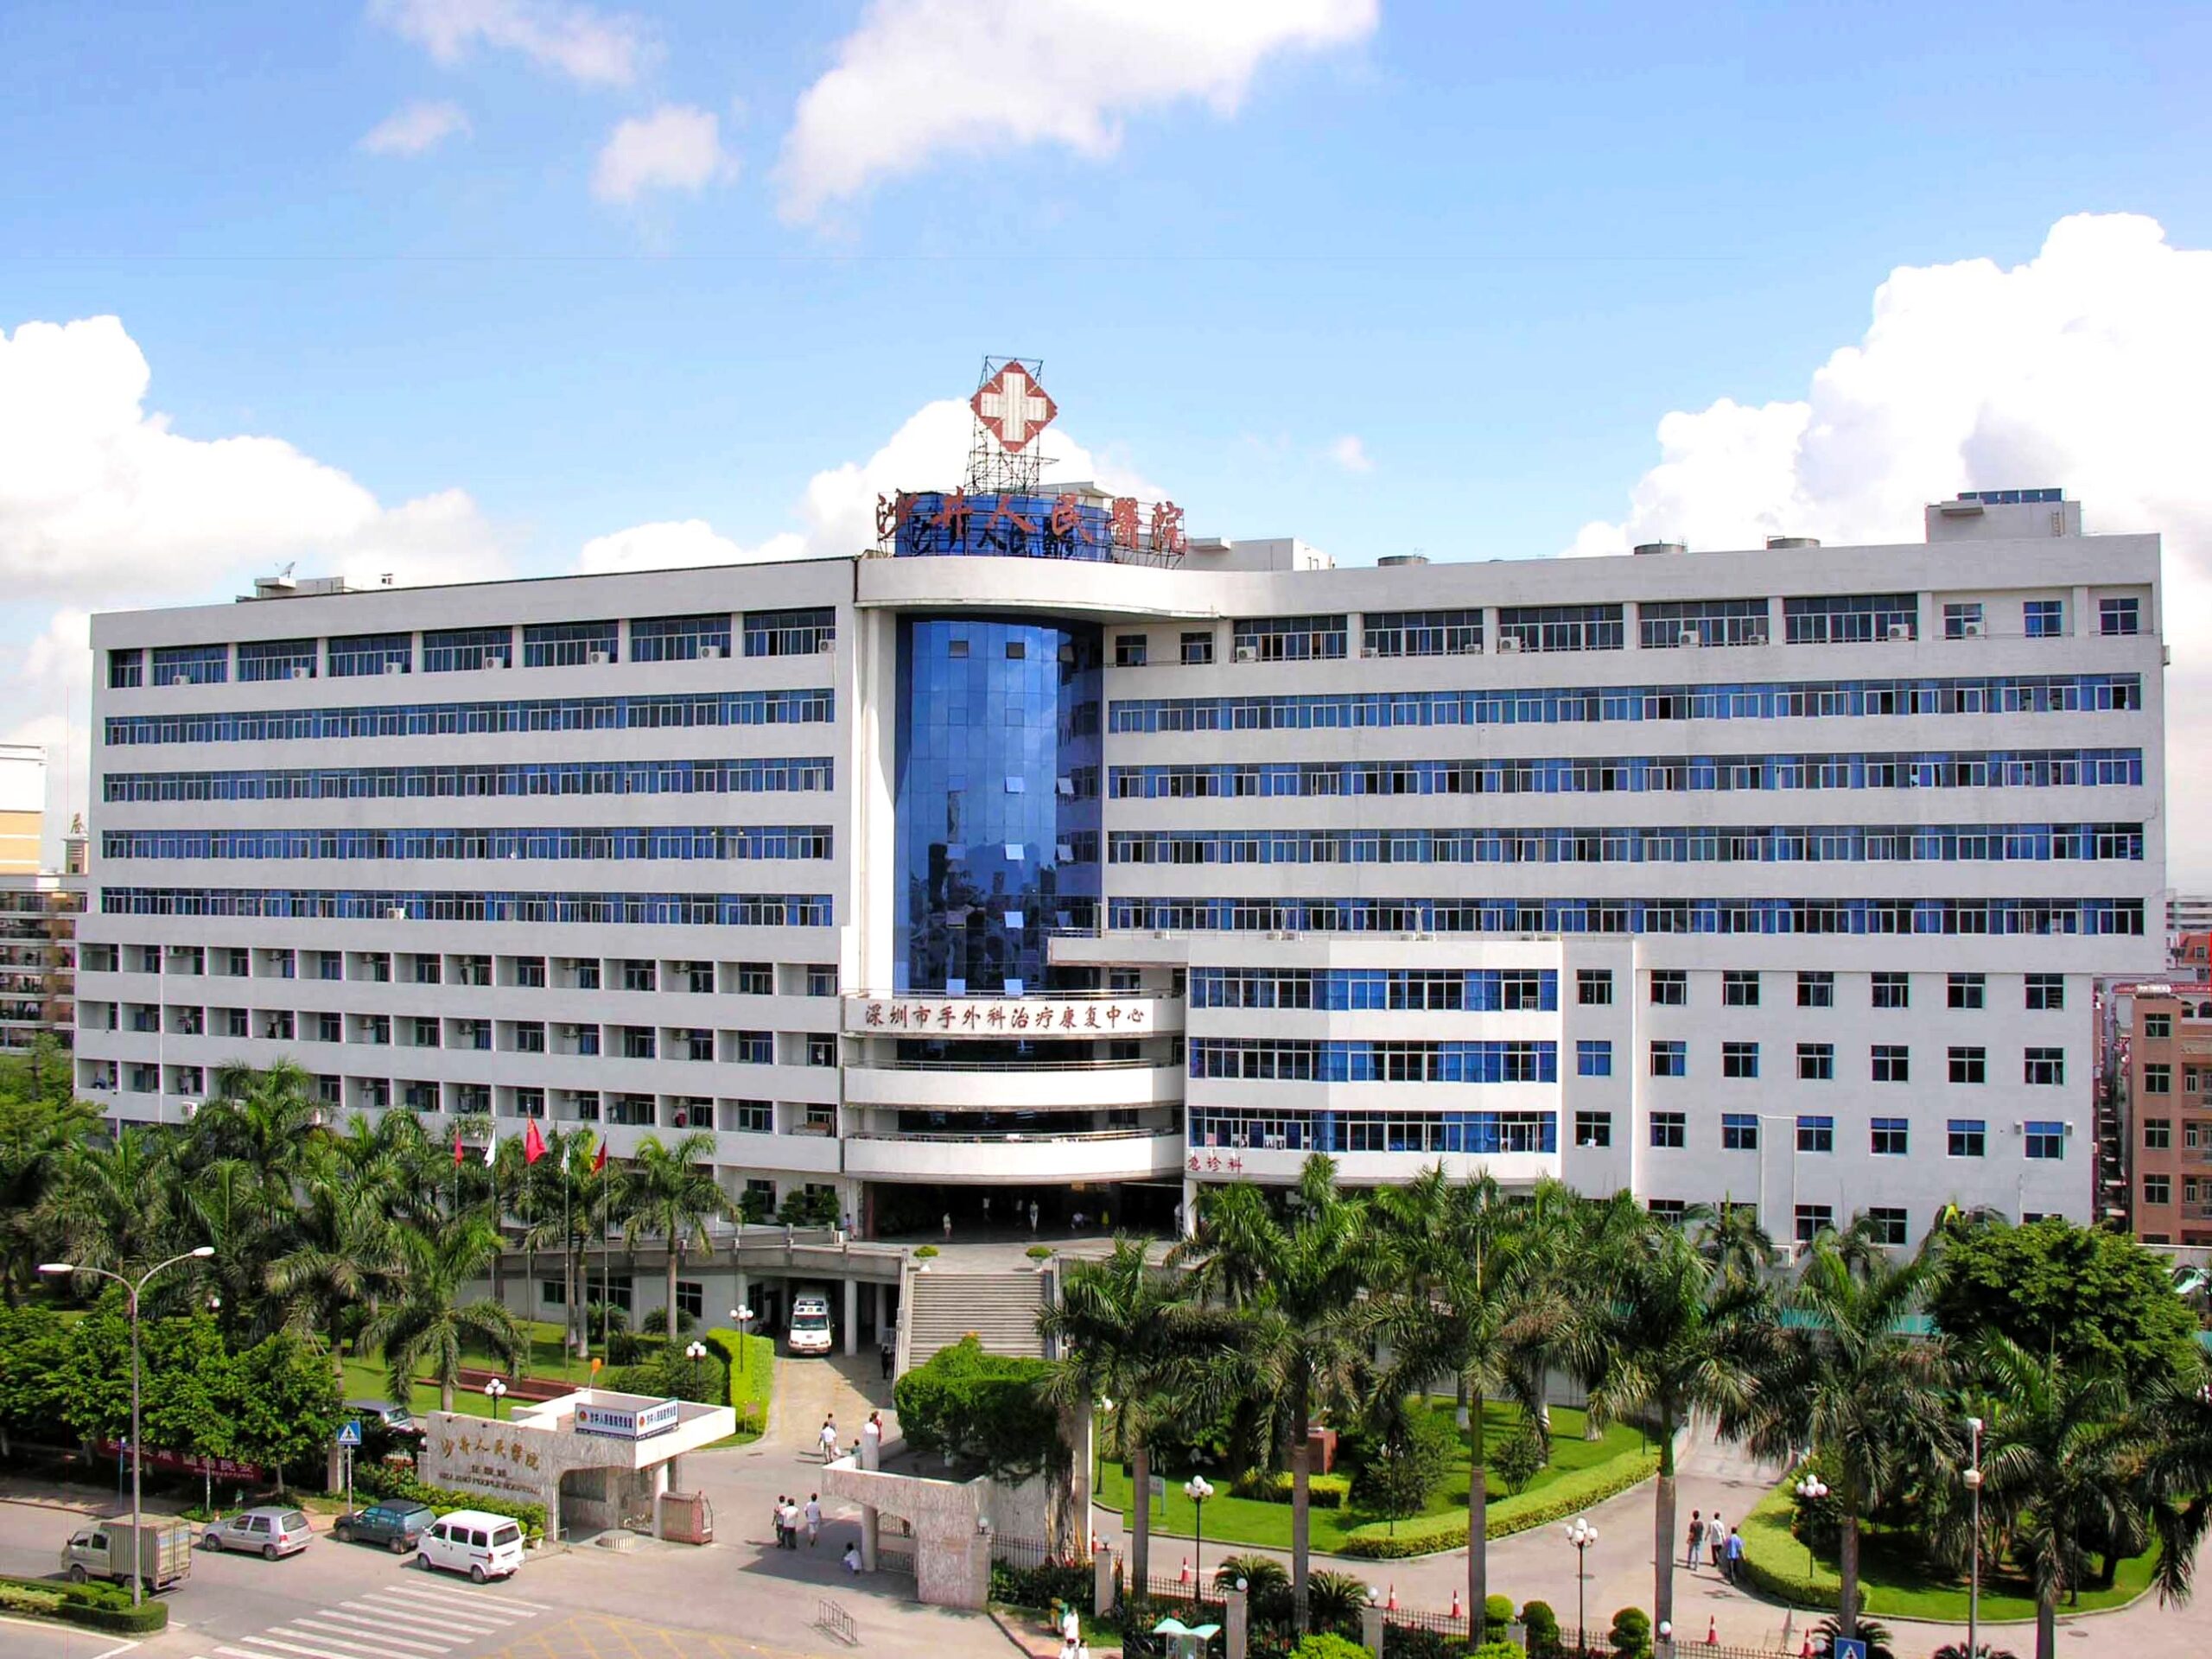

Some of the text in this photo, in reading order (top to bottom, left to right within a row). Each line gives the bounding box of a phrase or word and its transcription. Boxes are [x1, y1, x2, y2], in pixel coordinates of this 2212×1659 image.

[866, 1004, 1144, 1030] 深圳市手外科治疗康复中心
[1188, 1156, 1243, 1175] 急诊科
